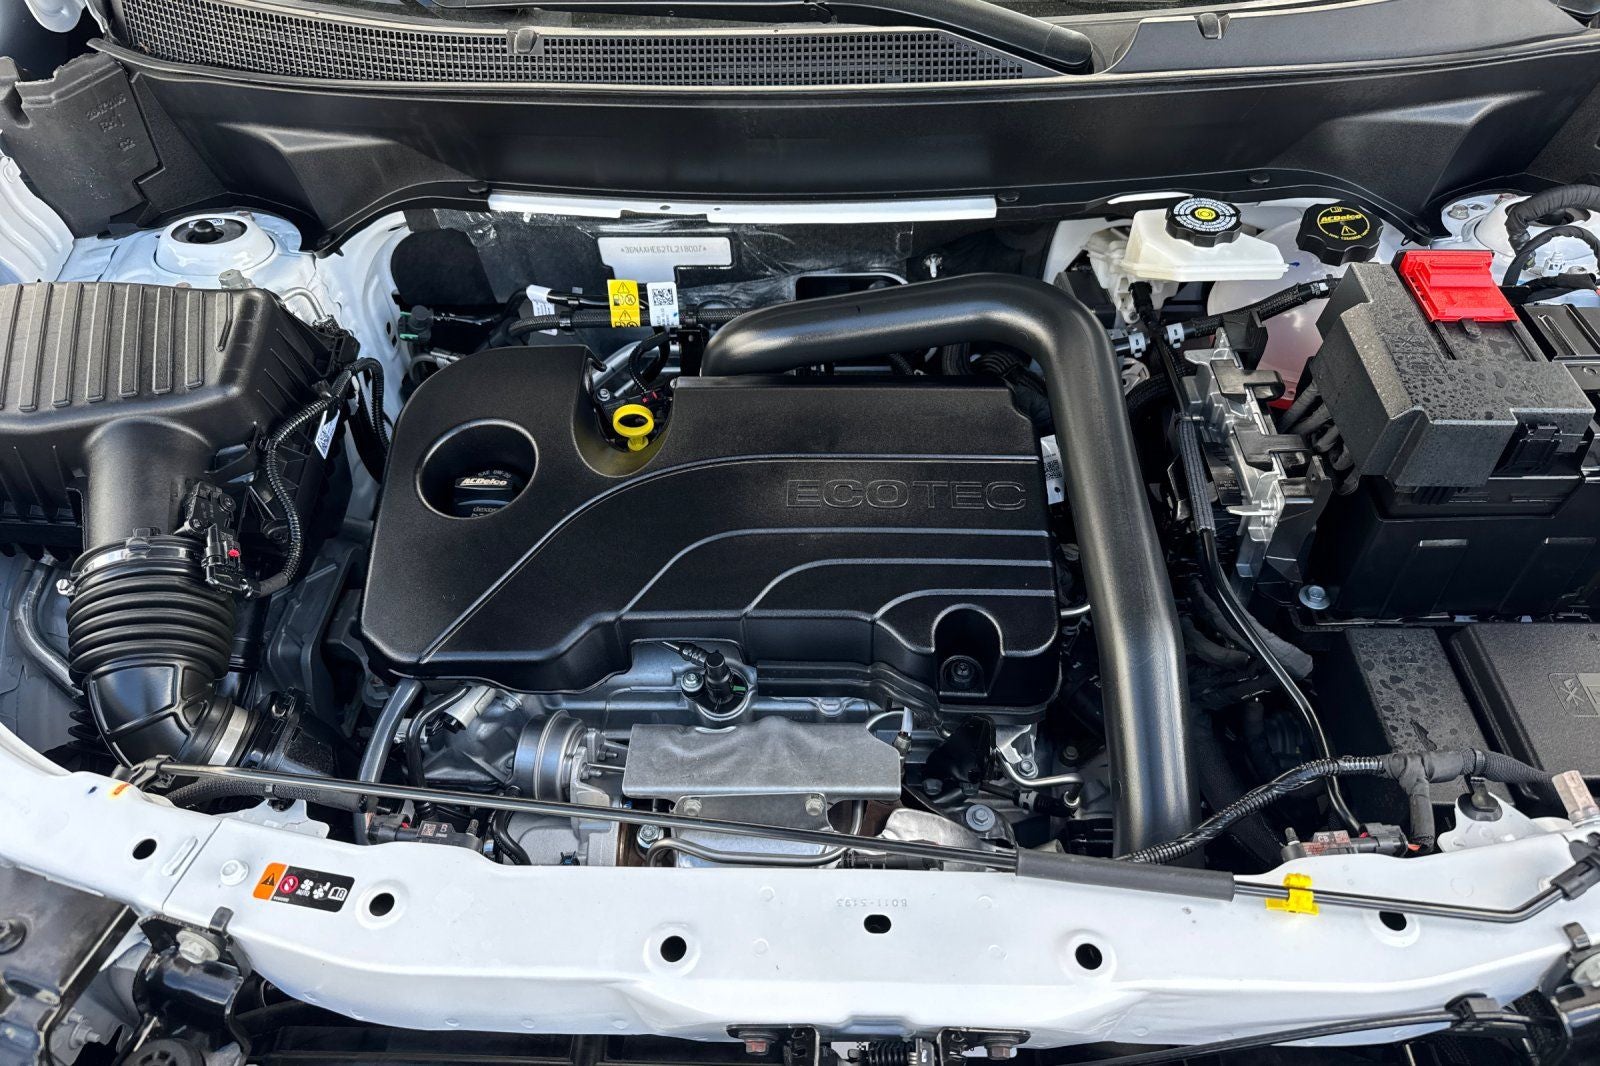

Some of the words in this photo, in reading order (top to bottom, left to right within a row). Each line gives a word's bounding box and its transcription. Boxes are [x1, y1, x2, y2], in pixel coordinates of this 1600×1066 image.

[1320, 214, 1362, 224] ACDelco
[460, 478, 508, 486] ACDelco
[787, 479, 1026, 510] ECOTEC
[295, 888, 311, 897] AUTO
